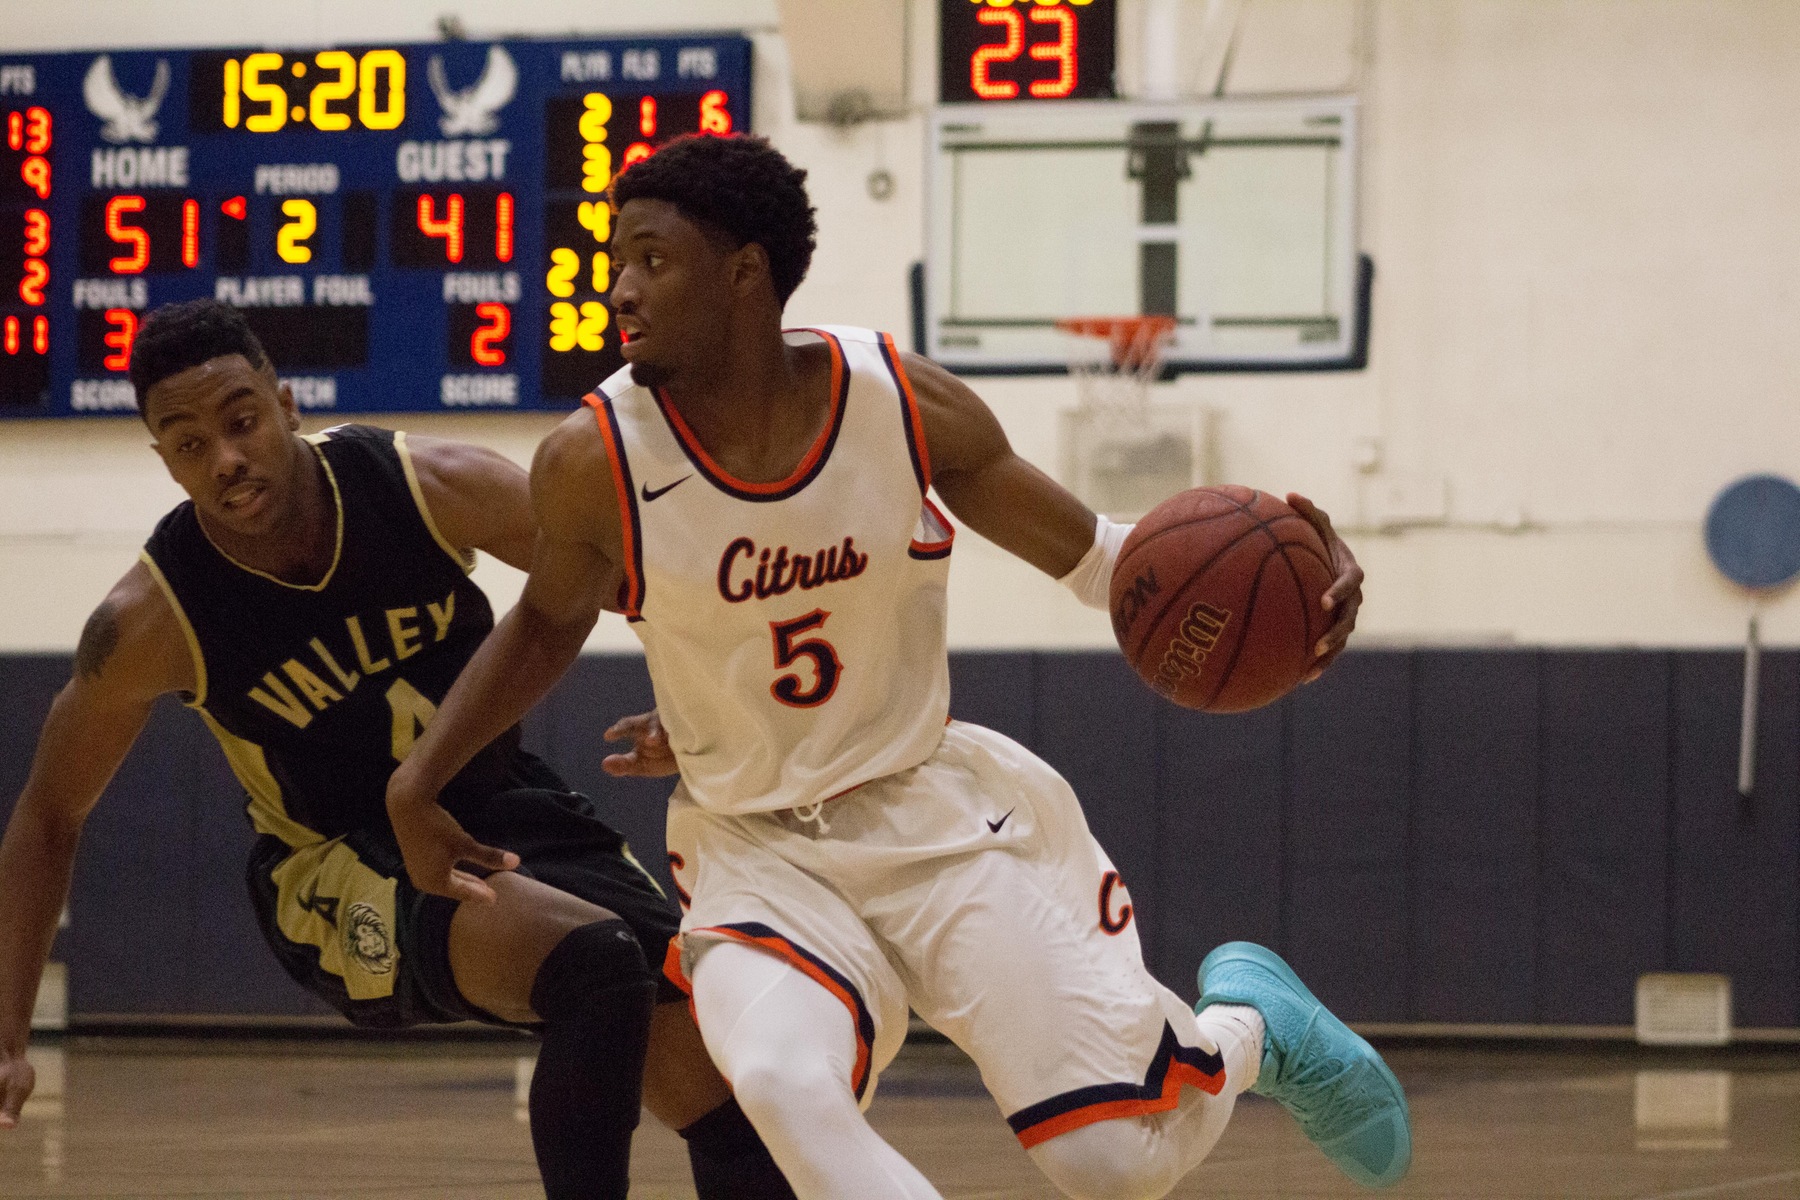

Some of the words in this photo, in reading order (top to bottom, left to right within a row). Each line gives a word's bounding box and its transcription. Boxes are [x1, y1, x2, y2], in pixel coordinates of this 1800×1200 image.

[970, 5, 1078, 99] 23
[223, 50, 405, 132] 15:20
[8, 106, 52, 154] 13
[579, 92, 612, 142] 2
[639, 95, 657, 137] 1
[21, 155, 52, 199] 9
[91, 147, 189, 188] HOME
[255, 164, 340, 195] PERIOD
[397, 140, 511, 183] GUEST
[581, 143, 612, 193] 3
[24, 208, 51, 257] 3
[105, 195, 199, 273] 51
[276, 199, 317, 263] 2
[417, 192, 514, 263] 41
[577, 201, 611, 243] 4
[19, 258, 50, 306] 2
[73, 278, 148, 309] FOULS
[214, 275, 305, 307] PLAYER
[313, 274, 374, 305] FOUL
[443, 271, 521, 304] FOULS
[546, 247, 610, 298] 21
[4, 315, 49, 355] 11
[103, 308, 138, 371] 3
[471, 302, 511, 366] 2
[549, 301, 609, 351] 32
[70, 379, 138, 411] SCOR
[441, 373, 519, 406] SCORE
[717, 536, 869, 604] Citrus
[247, 591, 456, 729] VALLEY
[768, 608, 845, 709] 5
[1098, 870, 1134, 937] C
